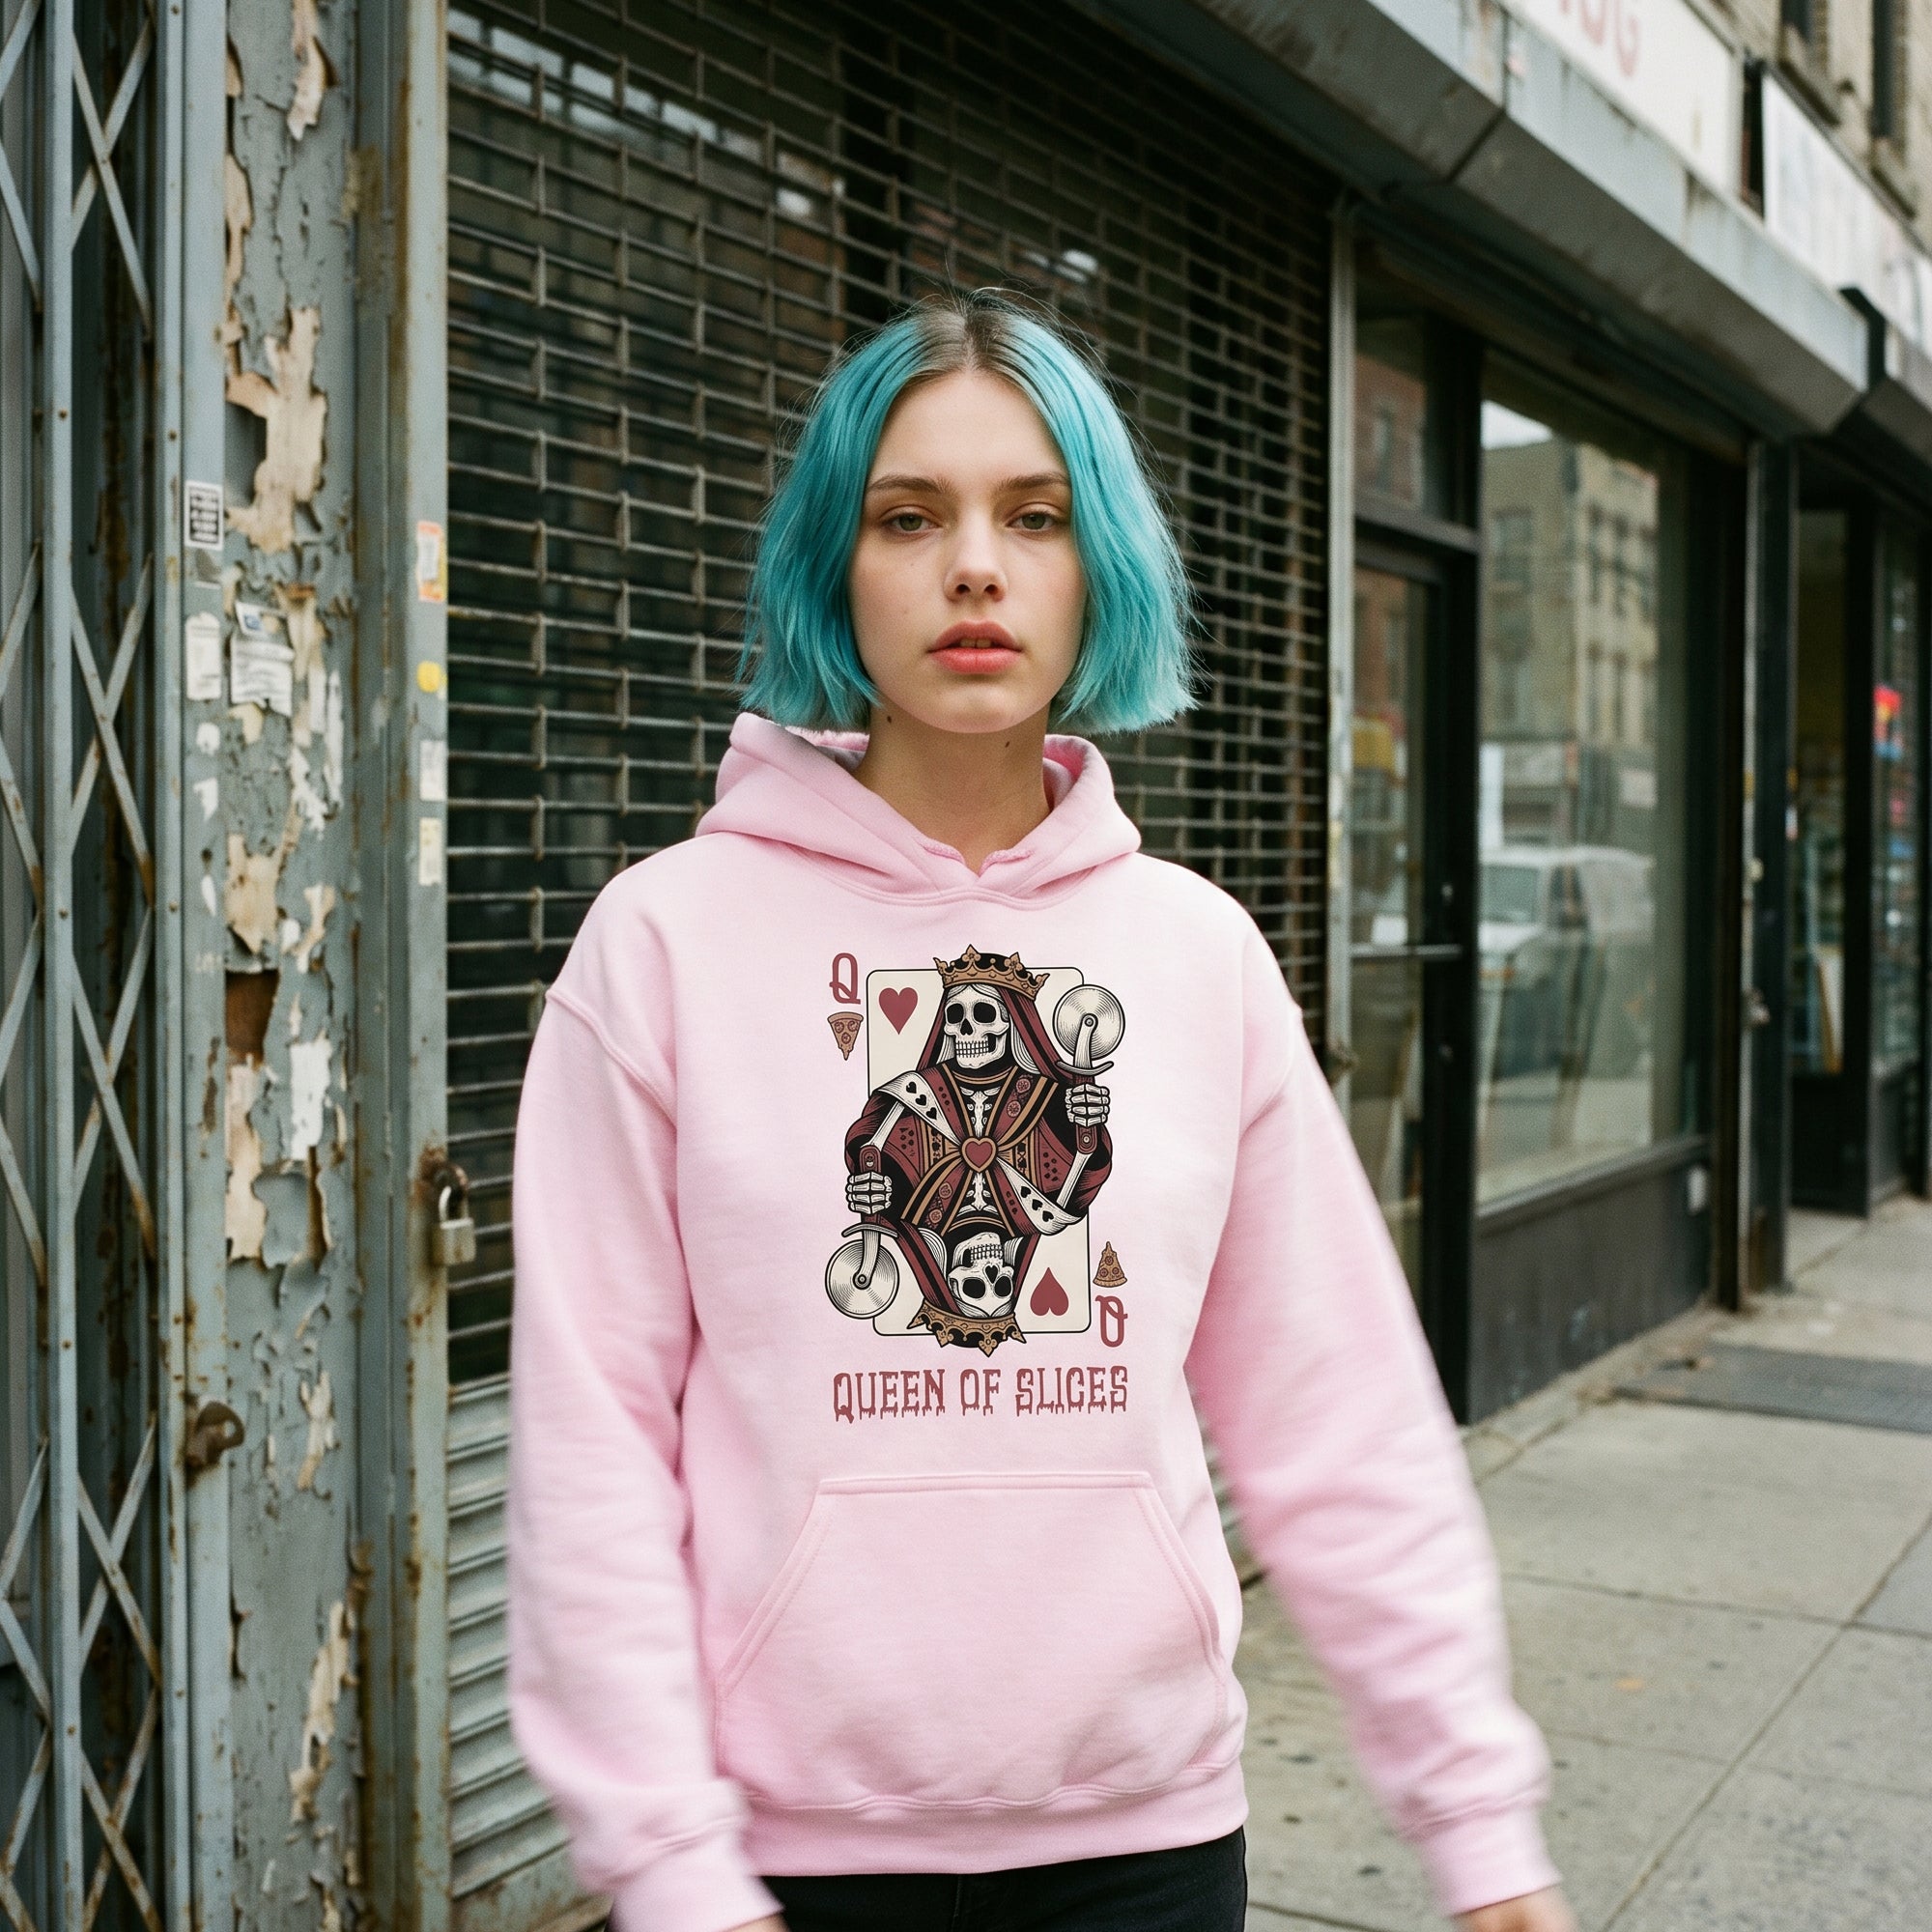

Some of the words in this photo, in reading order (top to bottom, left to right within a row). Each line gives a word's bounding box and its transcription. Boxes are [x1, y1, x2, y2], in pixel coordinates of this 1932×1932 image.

[829, 952, 861, 1005] Q
[1095, 1295, 1127, 1348] Q
[833, 1368, 946, 1424] QUEEN
[959, 1368, 1002, 1416] OF
[1014, 1365, 1128, 1417] SLICES
